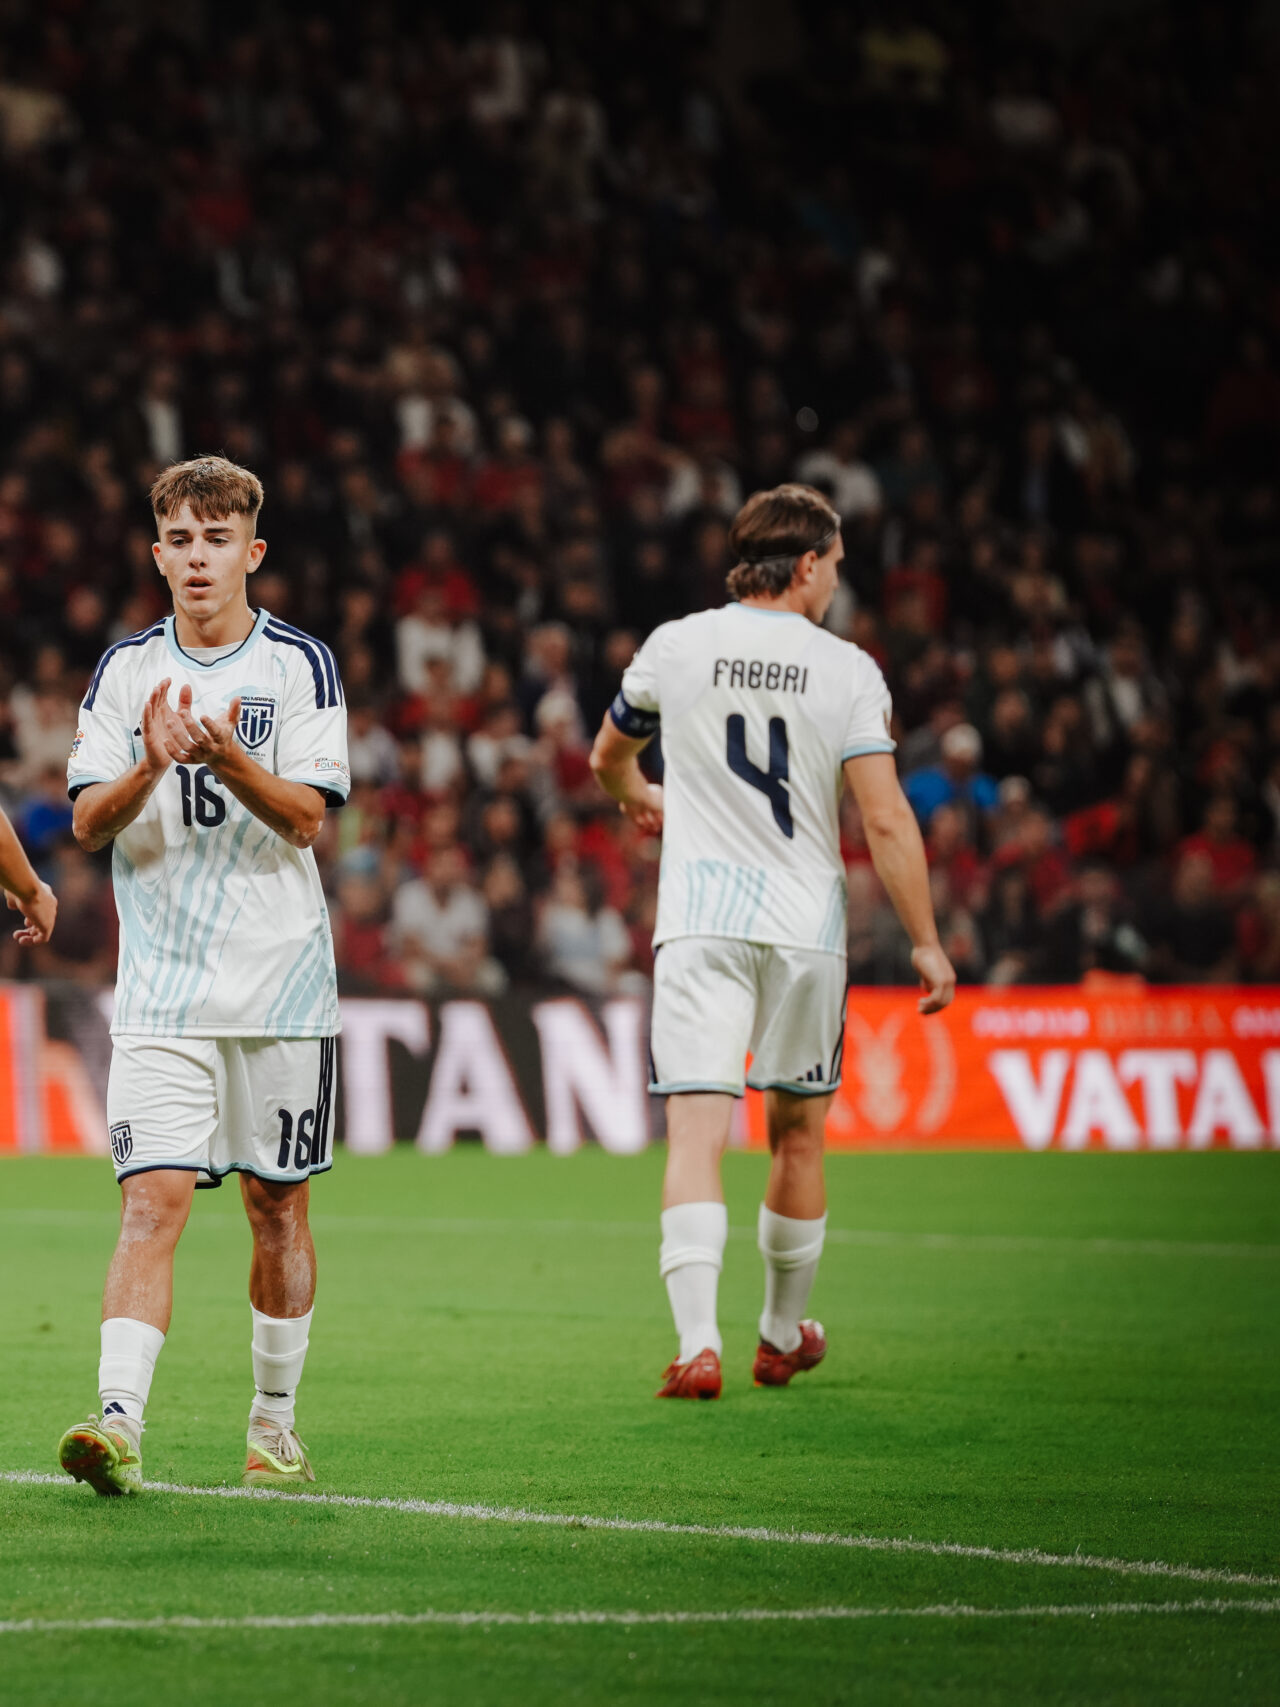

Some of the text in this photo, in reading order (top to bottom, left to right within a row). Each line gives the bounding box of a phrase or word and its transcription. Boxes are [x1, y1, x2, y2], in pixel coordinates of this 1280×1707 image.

[713, 658, 808, 694] FABBRI
[175, 764, 227, 828] 16
[726, 713, 794, 840] 4
[337, 998, 650, 1157] TAN
[989, 1048, 1280, 1151] VATA
[277, 1108, 315, 1170] 16
